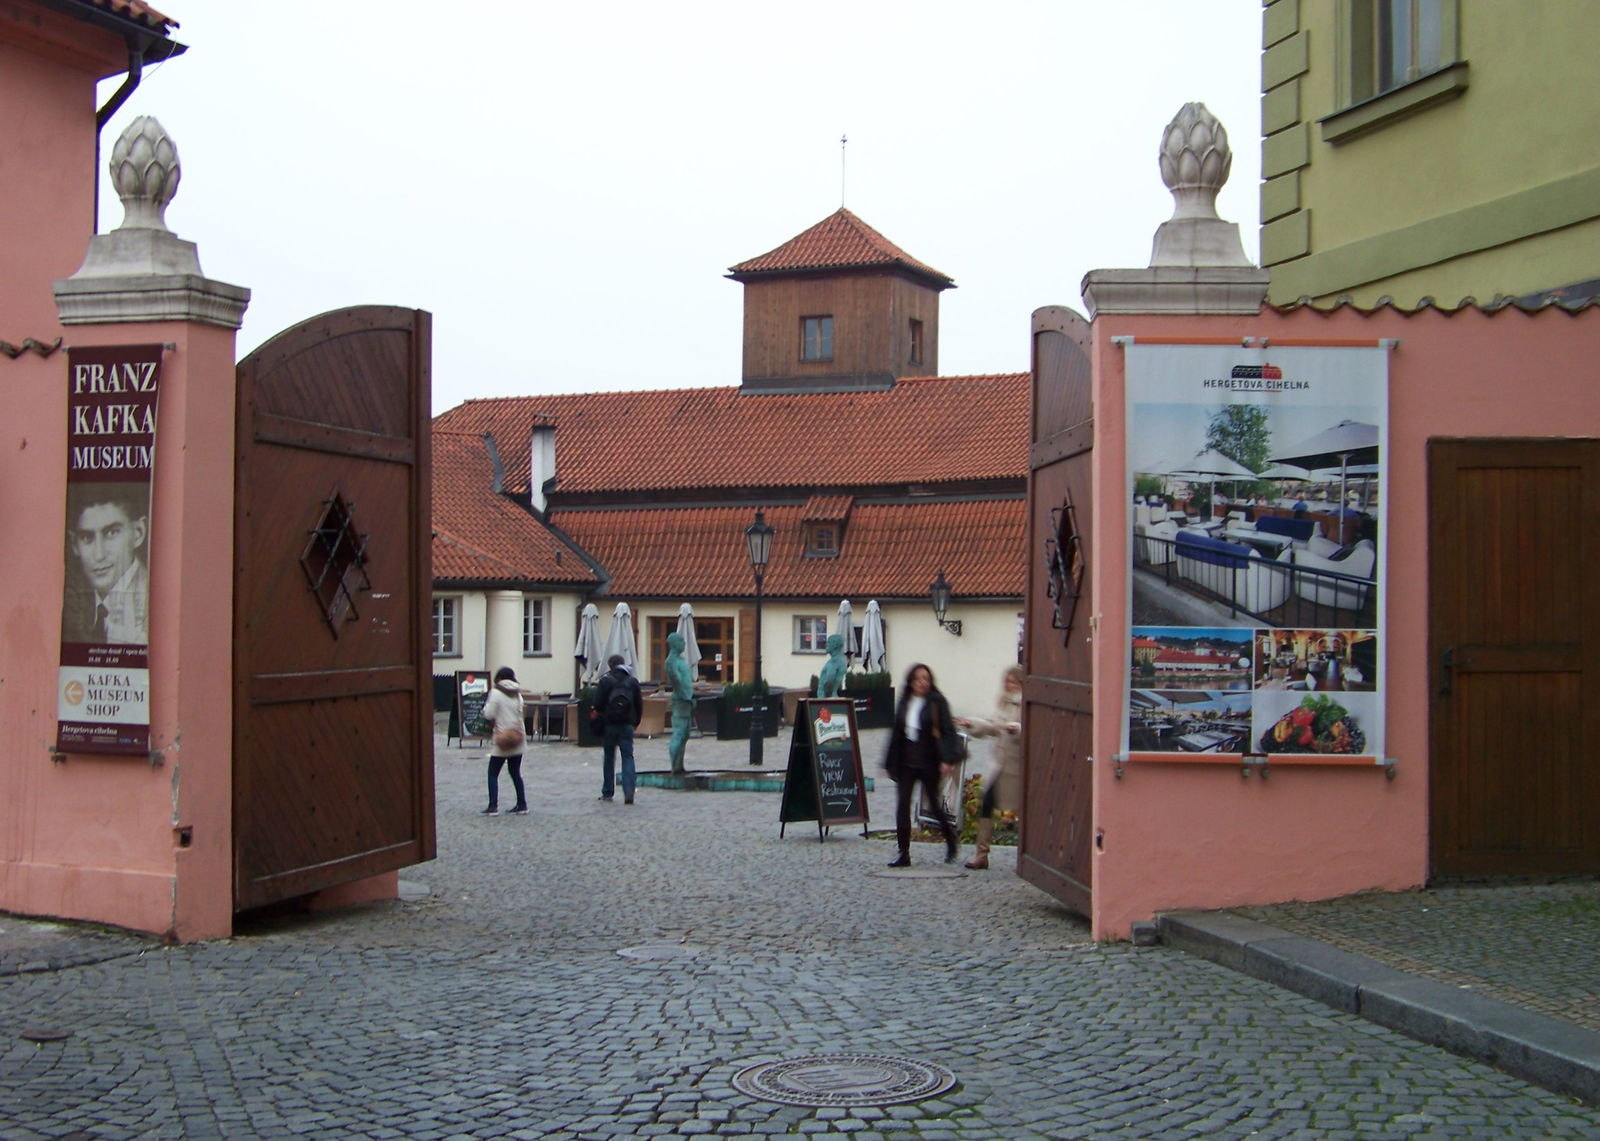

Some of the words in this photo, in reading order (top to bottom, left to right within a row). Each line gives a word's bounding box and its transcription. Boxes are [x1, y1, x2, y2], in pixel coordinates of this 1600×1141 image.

[74, 362, 157, 394] FRANZ
[1203, 379, 1263, 389] HERGETOVA
[1265, 380, 1310, 390] CIHELNA
[74, 404, 155, 435] KAFKA
[72, 445, 153, 470] MUSEUM
[87, 673, 130, 687] KAFKA
[87, 688, 144, 702] MUSEUM
[86, 703, 120, 717] SHOP
